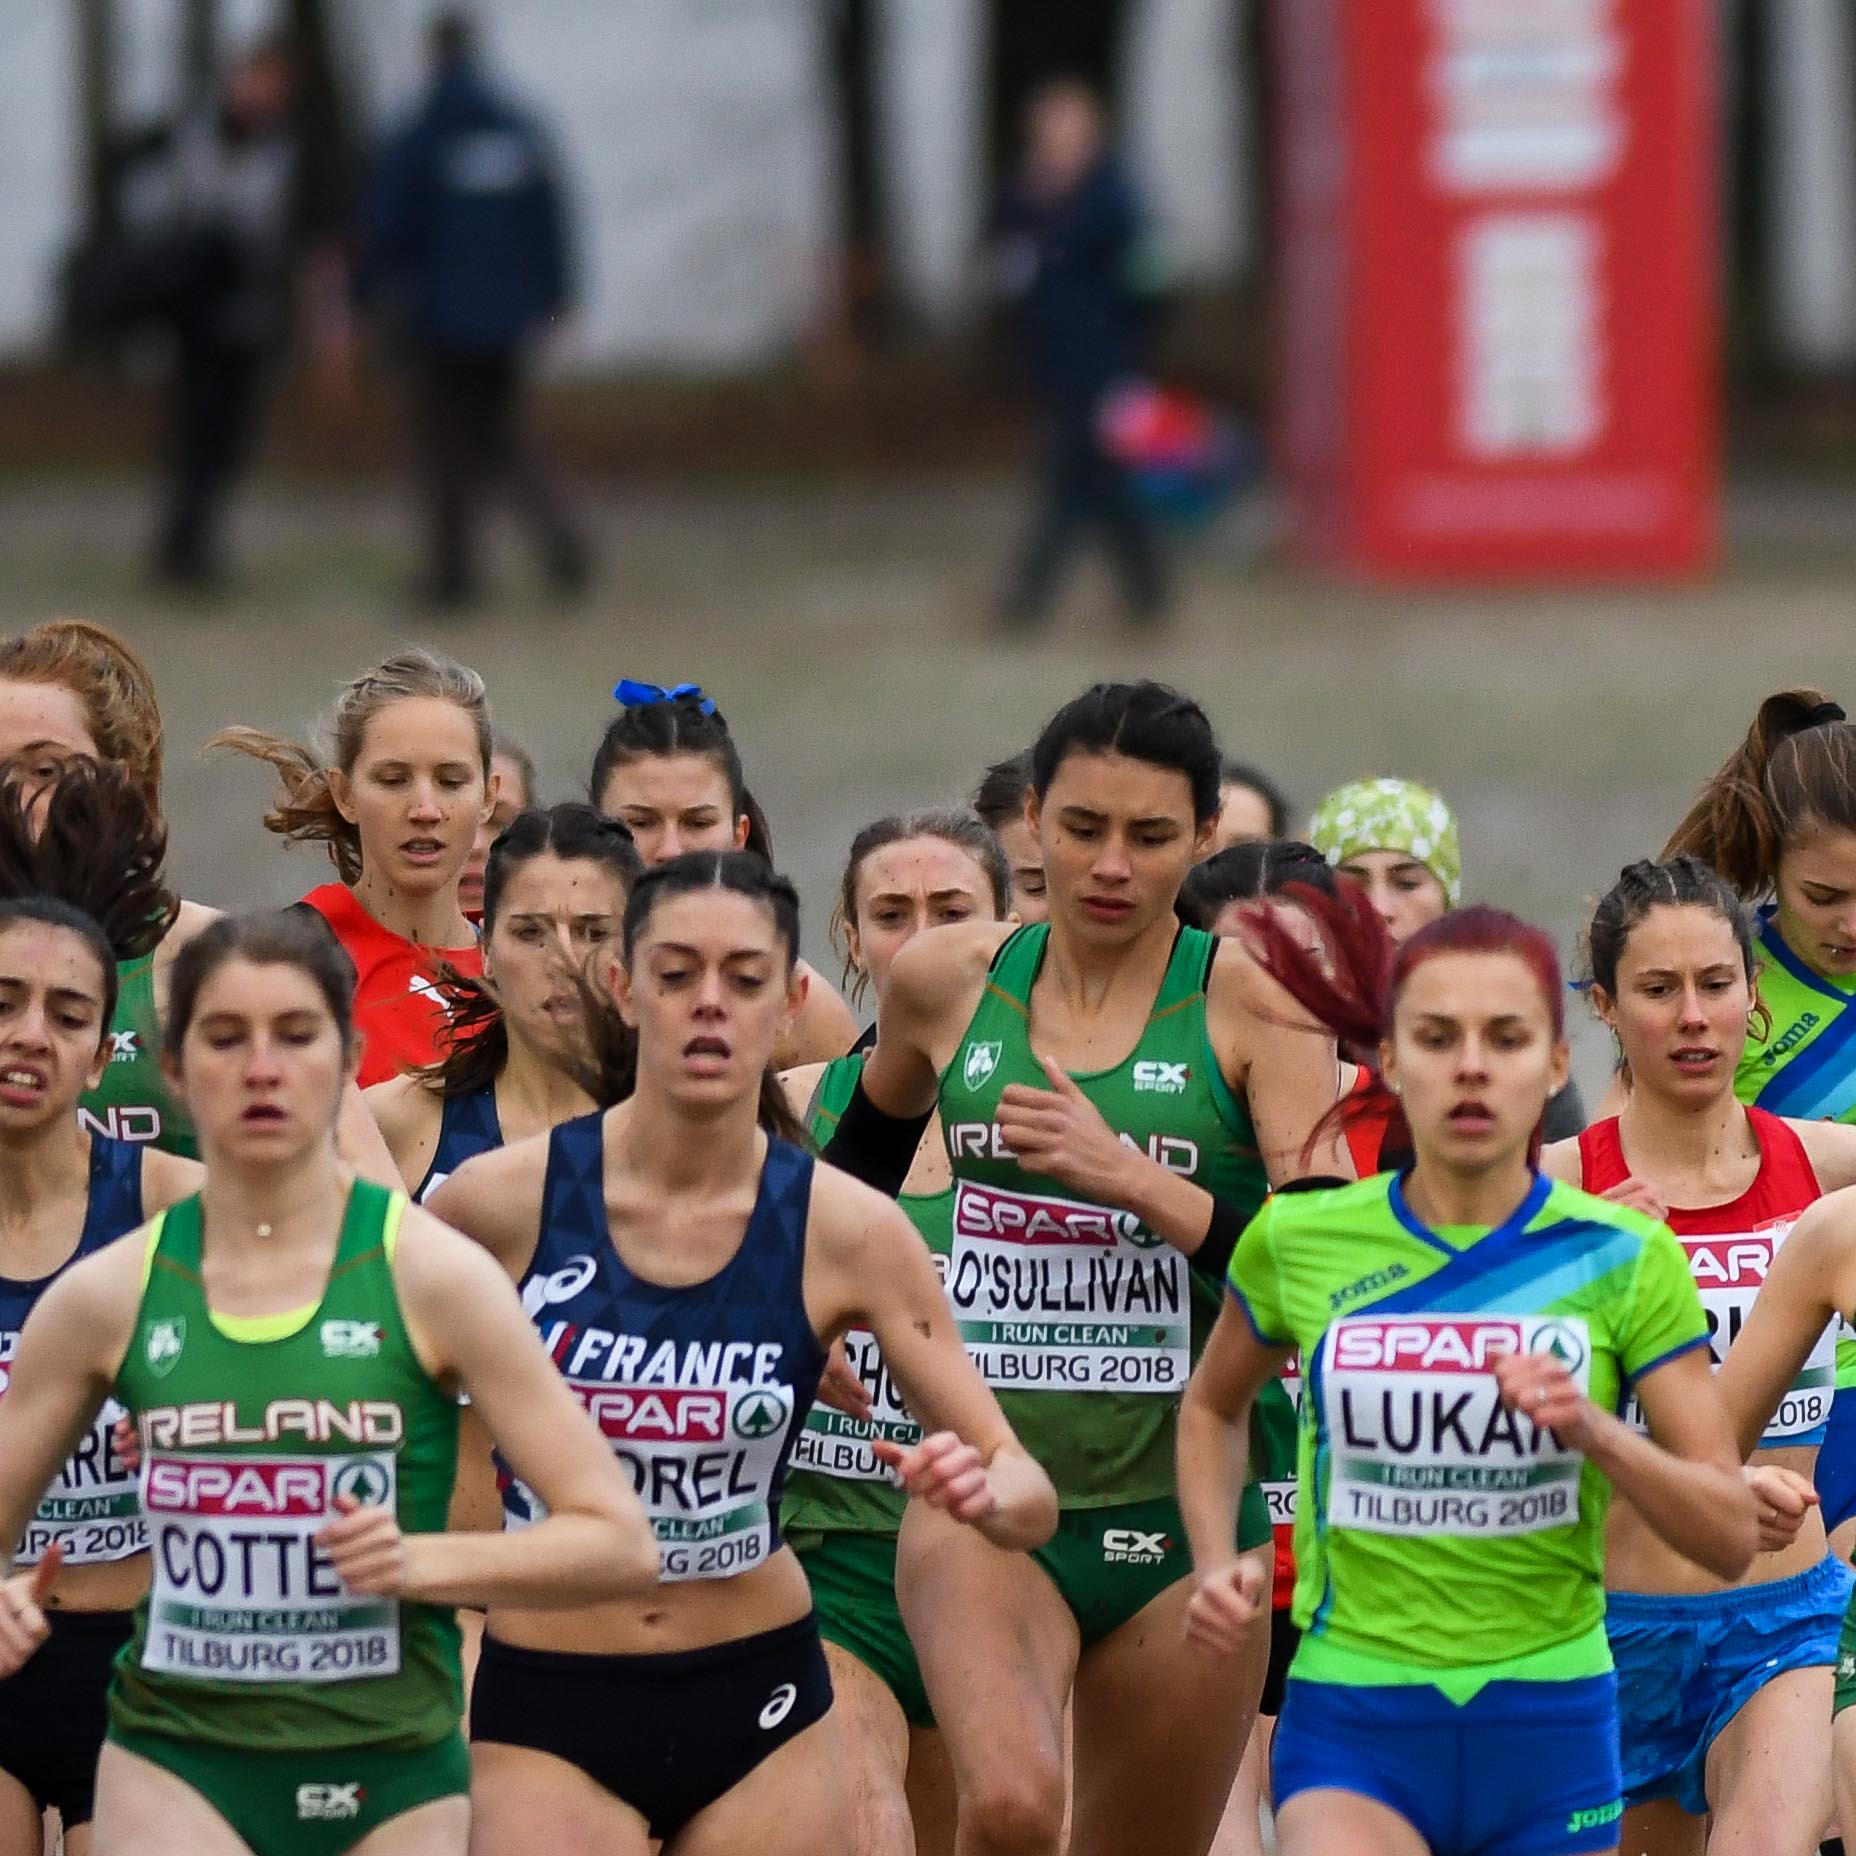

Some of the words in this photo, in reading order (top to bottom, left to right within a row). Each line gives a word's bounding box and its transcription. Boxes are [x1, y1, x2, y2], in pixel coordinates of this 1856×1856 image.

[1133, 1062, 1187, 1083] CX
[950, 1122, 1199, 1176] IREND
[959, 1193, 1112, 1241] SPAR
[952, 1250, 1180, 1314] O'SULLIVAN
[1690, 1244, 1770, 1283] AR
[992, 1325, 998, 1341] I
[1002, 1325, 1047, 1343] RUN
[1054, 1326, 1129, 1345] CLEAN
[1338, 1326, 1520, 1369] SPAR
[567, 1327, 784, 1388] FRANCE
[1099, 1355, 1176, 1384] 2018
[139, 1400, 403, 1449] IRELAND
[573, 1391, 723, 1437] PAR
[839, 1417, 886, 1439] RUN
[150, 1463, 324, 1513] SPAR
[615, 1450, 758, 1511] REL
[1348, 1488, 1489, 1528] TILBURG
[1499, 1489, 1568, 1526] 2018
[162, 1524, 341, 1598] COTTE
[699, 1534, 761, 1573] 2018
[1103, 1529, 1166, 1554] CX
[1104, 1551, 1165, 1566] SPORT
[165, 1633, 302, 1672] TILBURG
[310, 1635, 389, 1672] 2018
